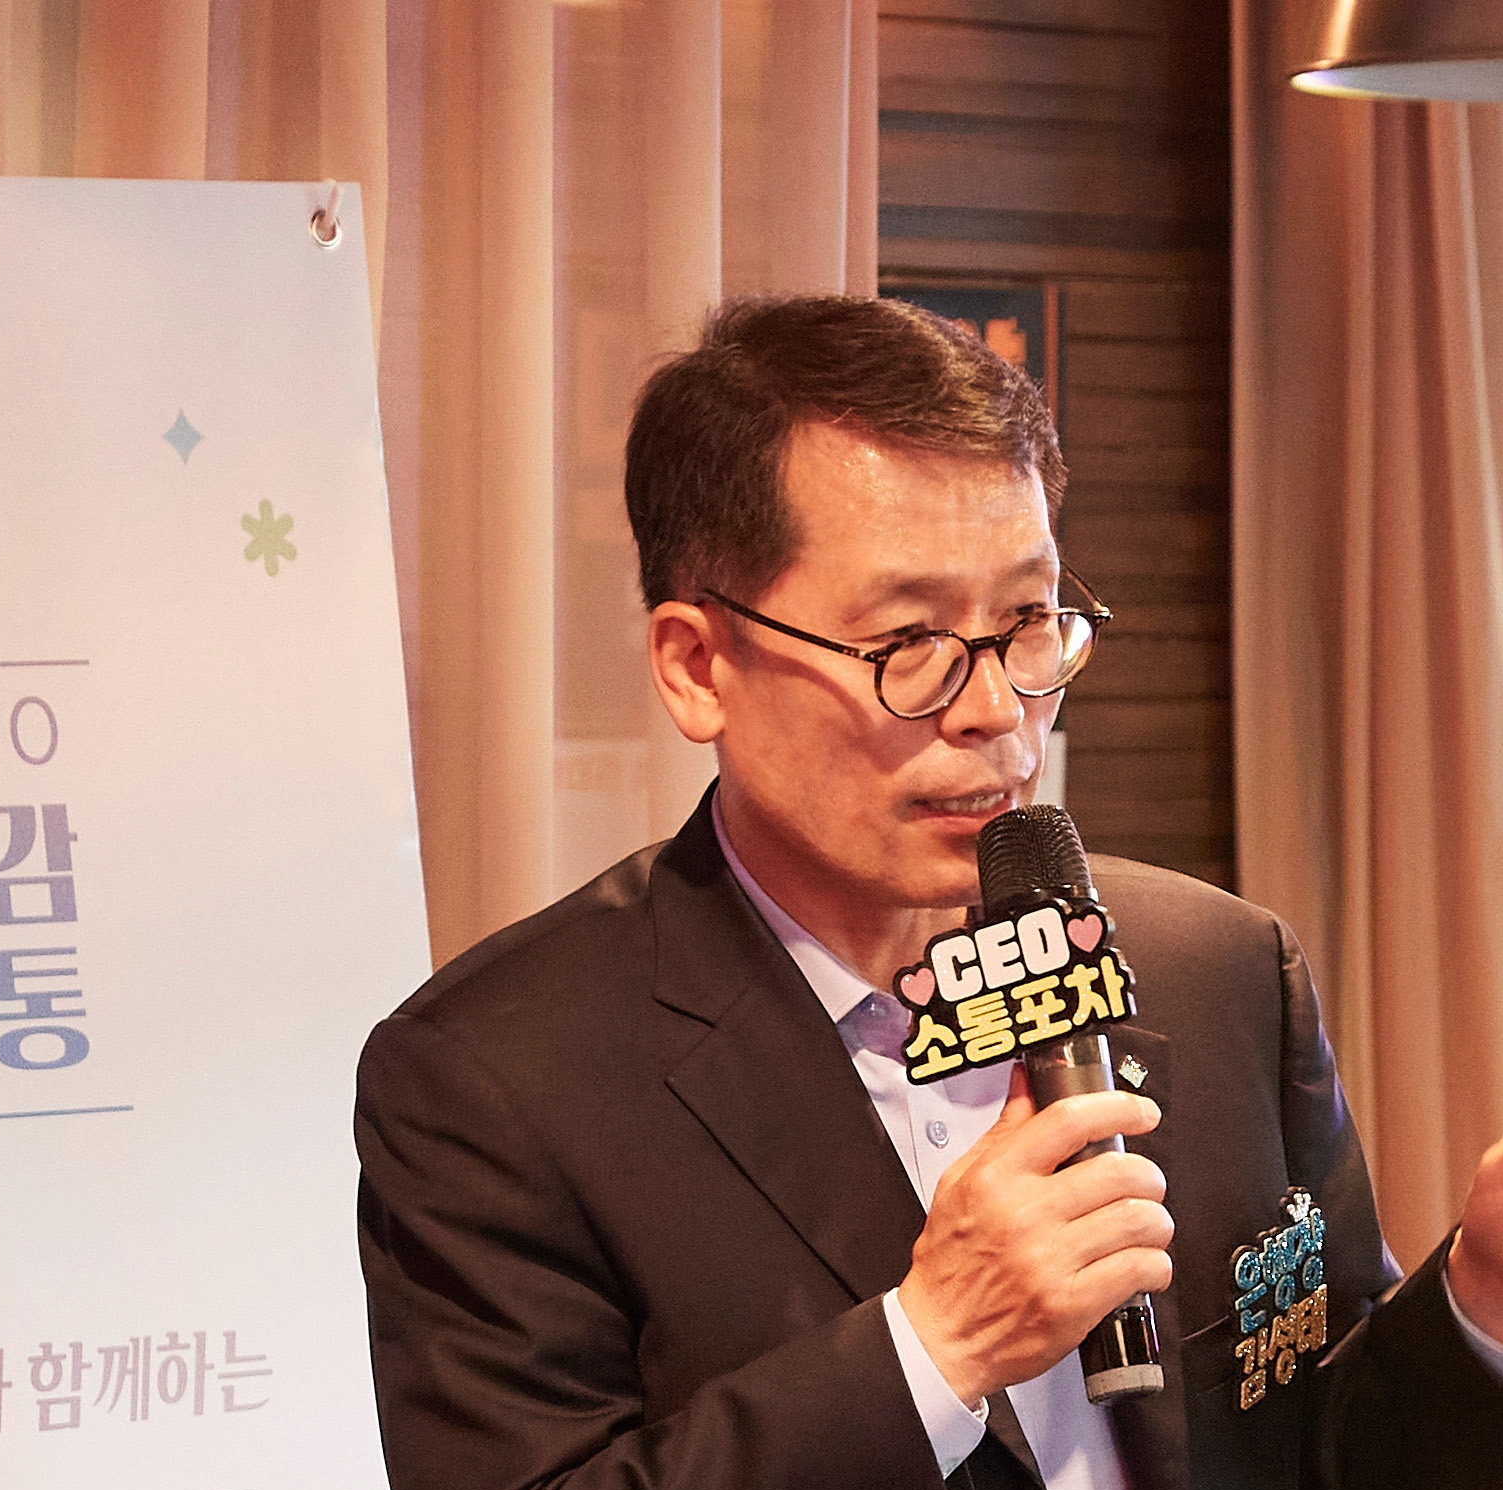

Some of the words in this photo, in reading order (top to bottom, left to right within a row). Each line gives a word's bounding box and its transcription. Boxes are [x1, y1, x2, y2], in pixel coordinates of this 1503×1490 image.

[931, 907, 1071, 1003] CEO
[906, 955, 1125, 1080] 소통포차
[27, 1329, 274, 1432] 함께하는
